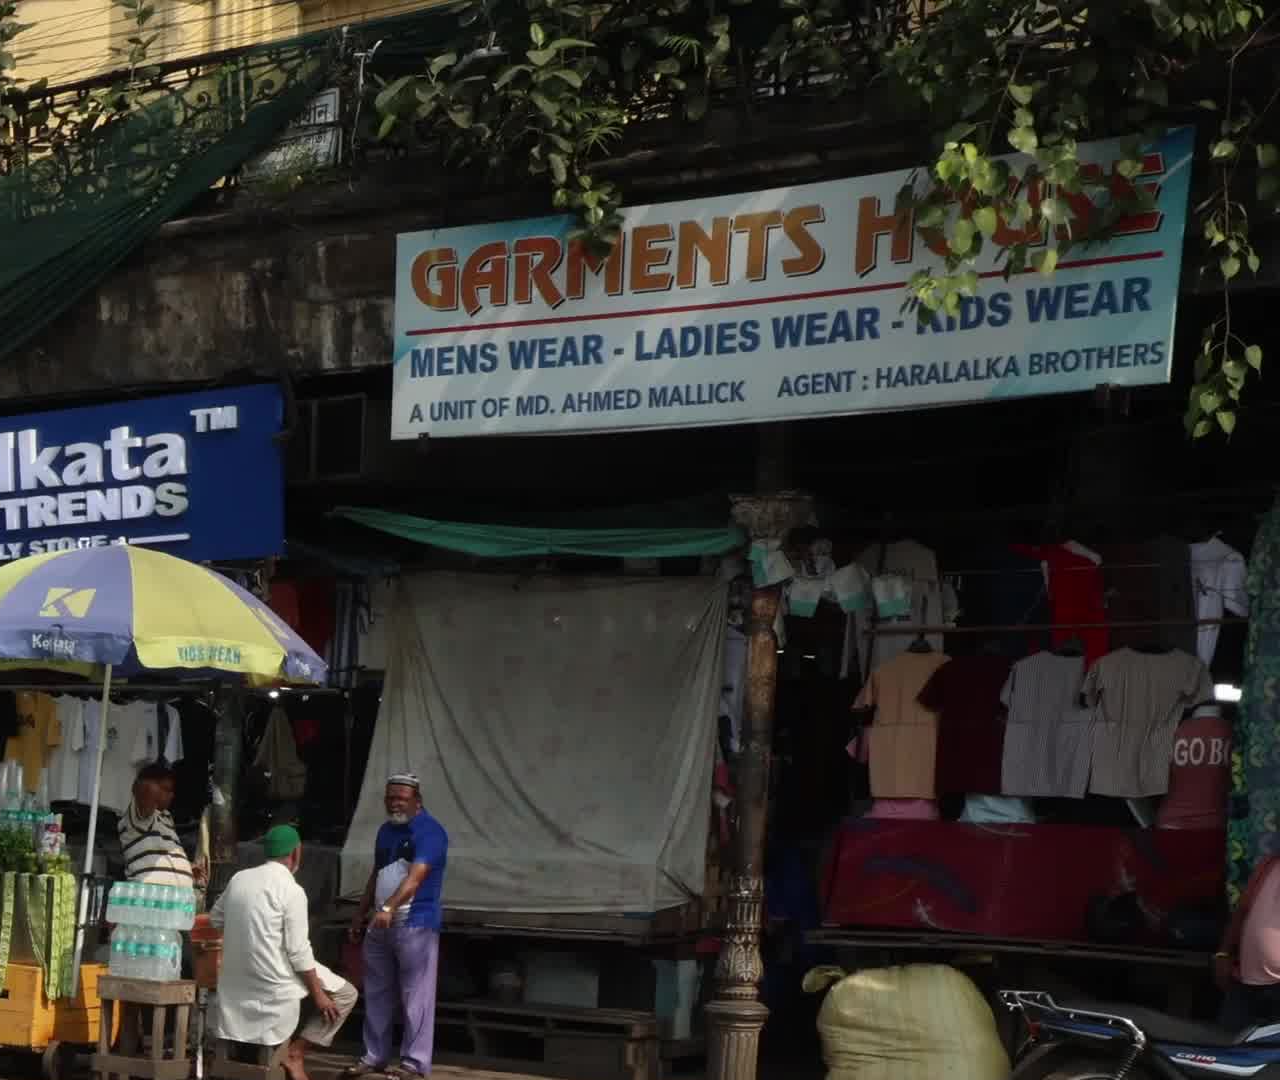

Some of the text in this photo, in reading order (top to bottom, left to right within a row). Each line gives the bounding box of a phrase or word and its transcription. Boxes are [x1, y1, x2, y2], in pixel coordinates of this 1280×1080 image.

[409, 204, 827, 317] GARMENTS
[410, 341, 499, 378] MENS
[508, 333, 605, 370] WEAR
[634, 319, 761, 362] LADIES
[771, 306, 881, 350] WEAR
[1025, 276, 1153, 323] WEAR
[189, 405, 239, 433] TM
[409, 403, 424, 423] A
[429, 399, 477, 422] UNIT
[482, 397, 510, 418] OF
[515, 393, 556, 417] MD.
[561, 388, 641, 414] AHMED
[647, 380, 747, 408] MALLICK
[777, 369, 856, 398] AGENT
[875, 355, 1020, 389] HARALALKA
[1028, 340, 1166, 377] BROTHERS
[1174, 737, 1205, 767] GO
